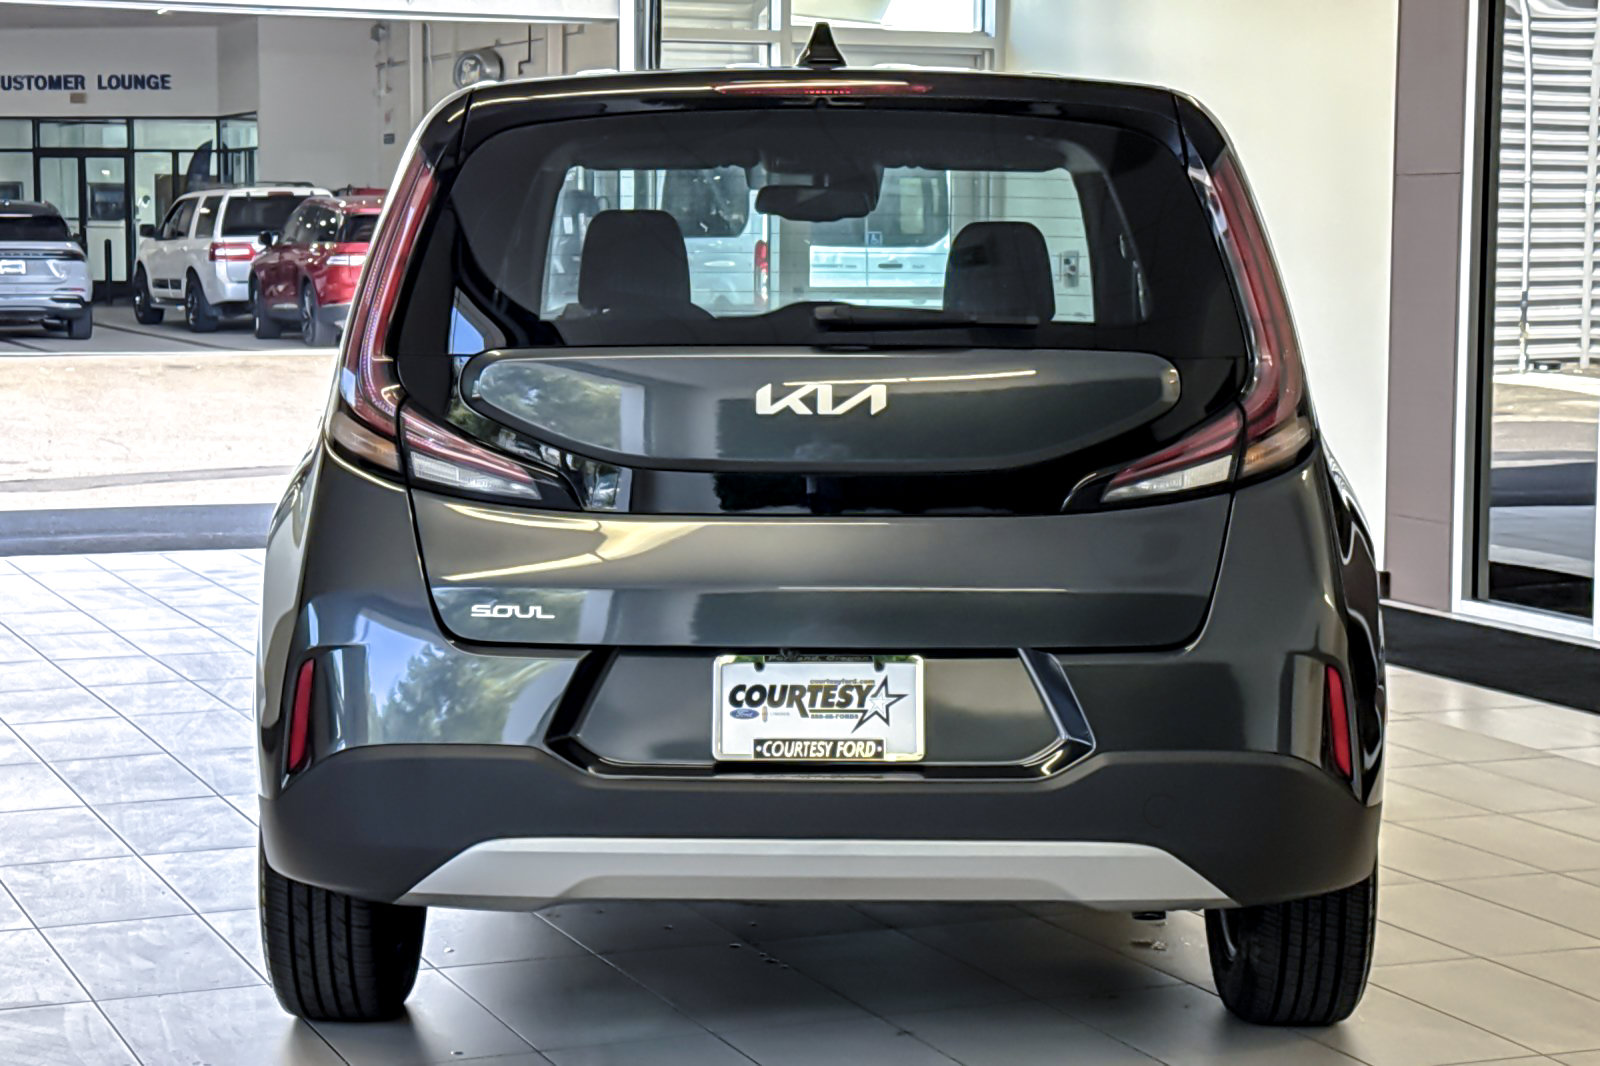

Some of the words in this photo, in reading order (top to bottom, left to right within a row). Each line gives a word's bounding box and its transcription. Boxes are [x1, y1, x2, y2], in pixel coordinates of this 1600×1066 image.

[97, 74, 172, 90] LOUNGE
[755, 383, 887, 415] KIA
[470, 604, 556, 619] SOUL
[728, 684, 875, 718] COURTESY
[762, 740, 833, 758] COURTESY
[836, 740, 876, 758] FORD
